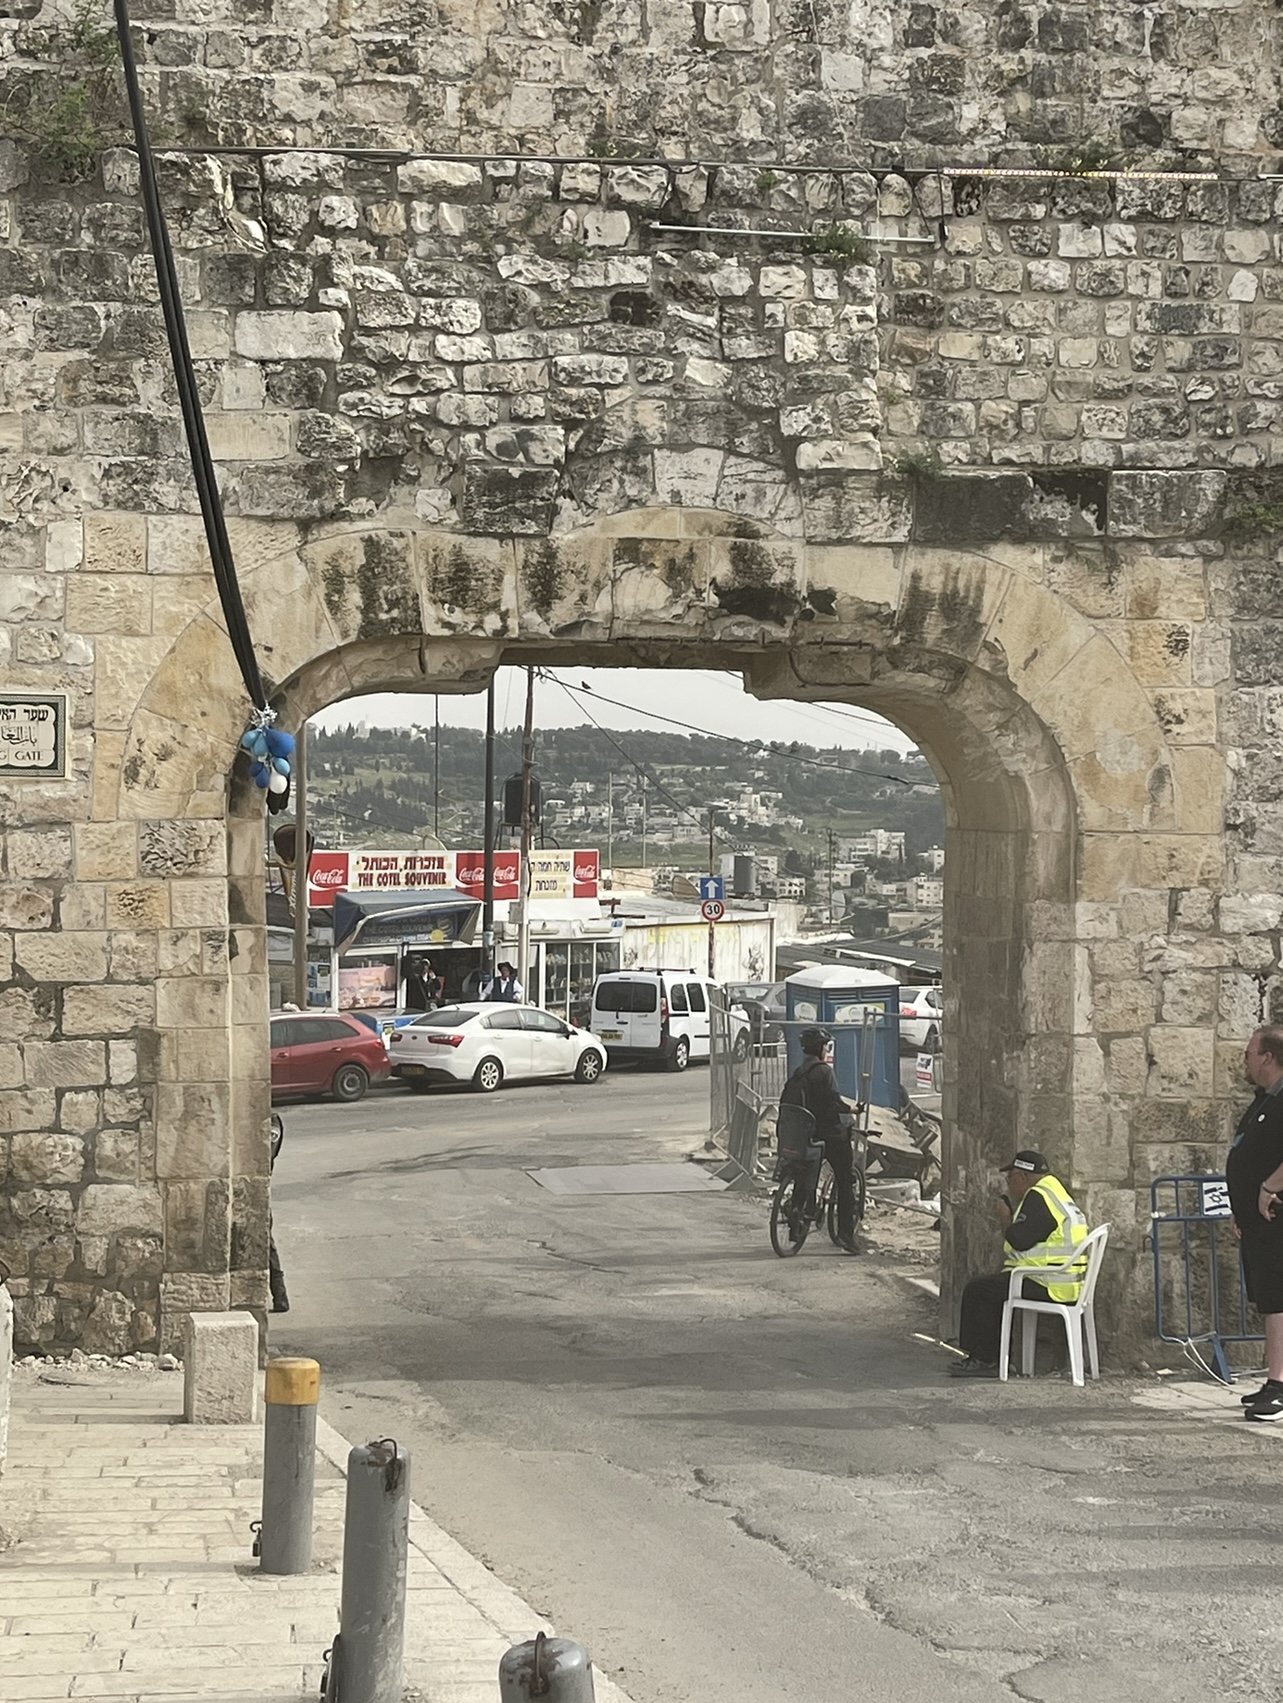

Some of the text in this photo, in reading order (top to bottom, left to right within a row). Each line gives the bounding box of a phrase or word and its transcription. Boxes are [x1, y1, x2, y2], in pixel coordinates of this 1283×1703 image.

[23, 709, 49, 721] שער
[15, 750, 43, 761] GATE
[361, 856, 398, 871] הכותל
[358, 871, 447, 887] THE COTEL SOUVENIR
[706, 903, 720, 915] 30
